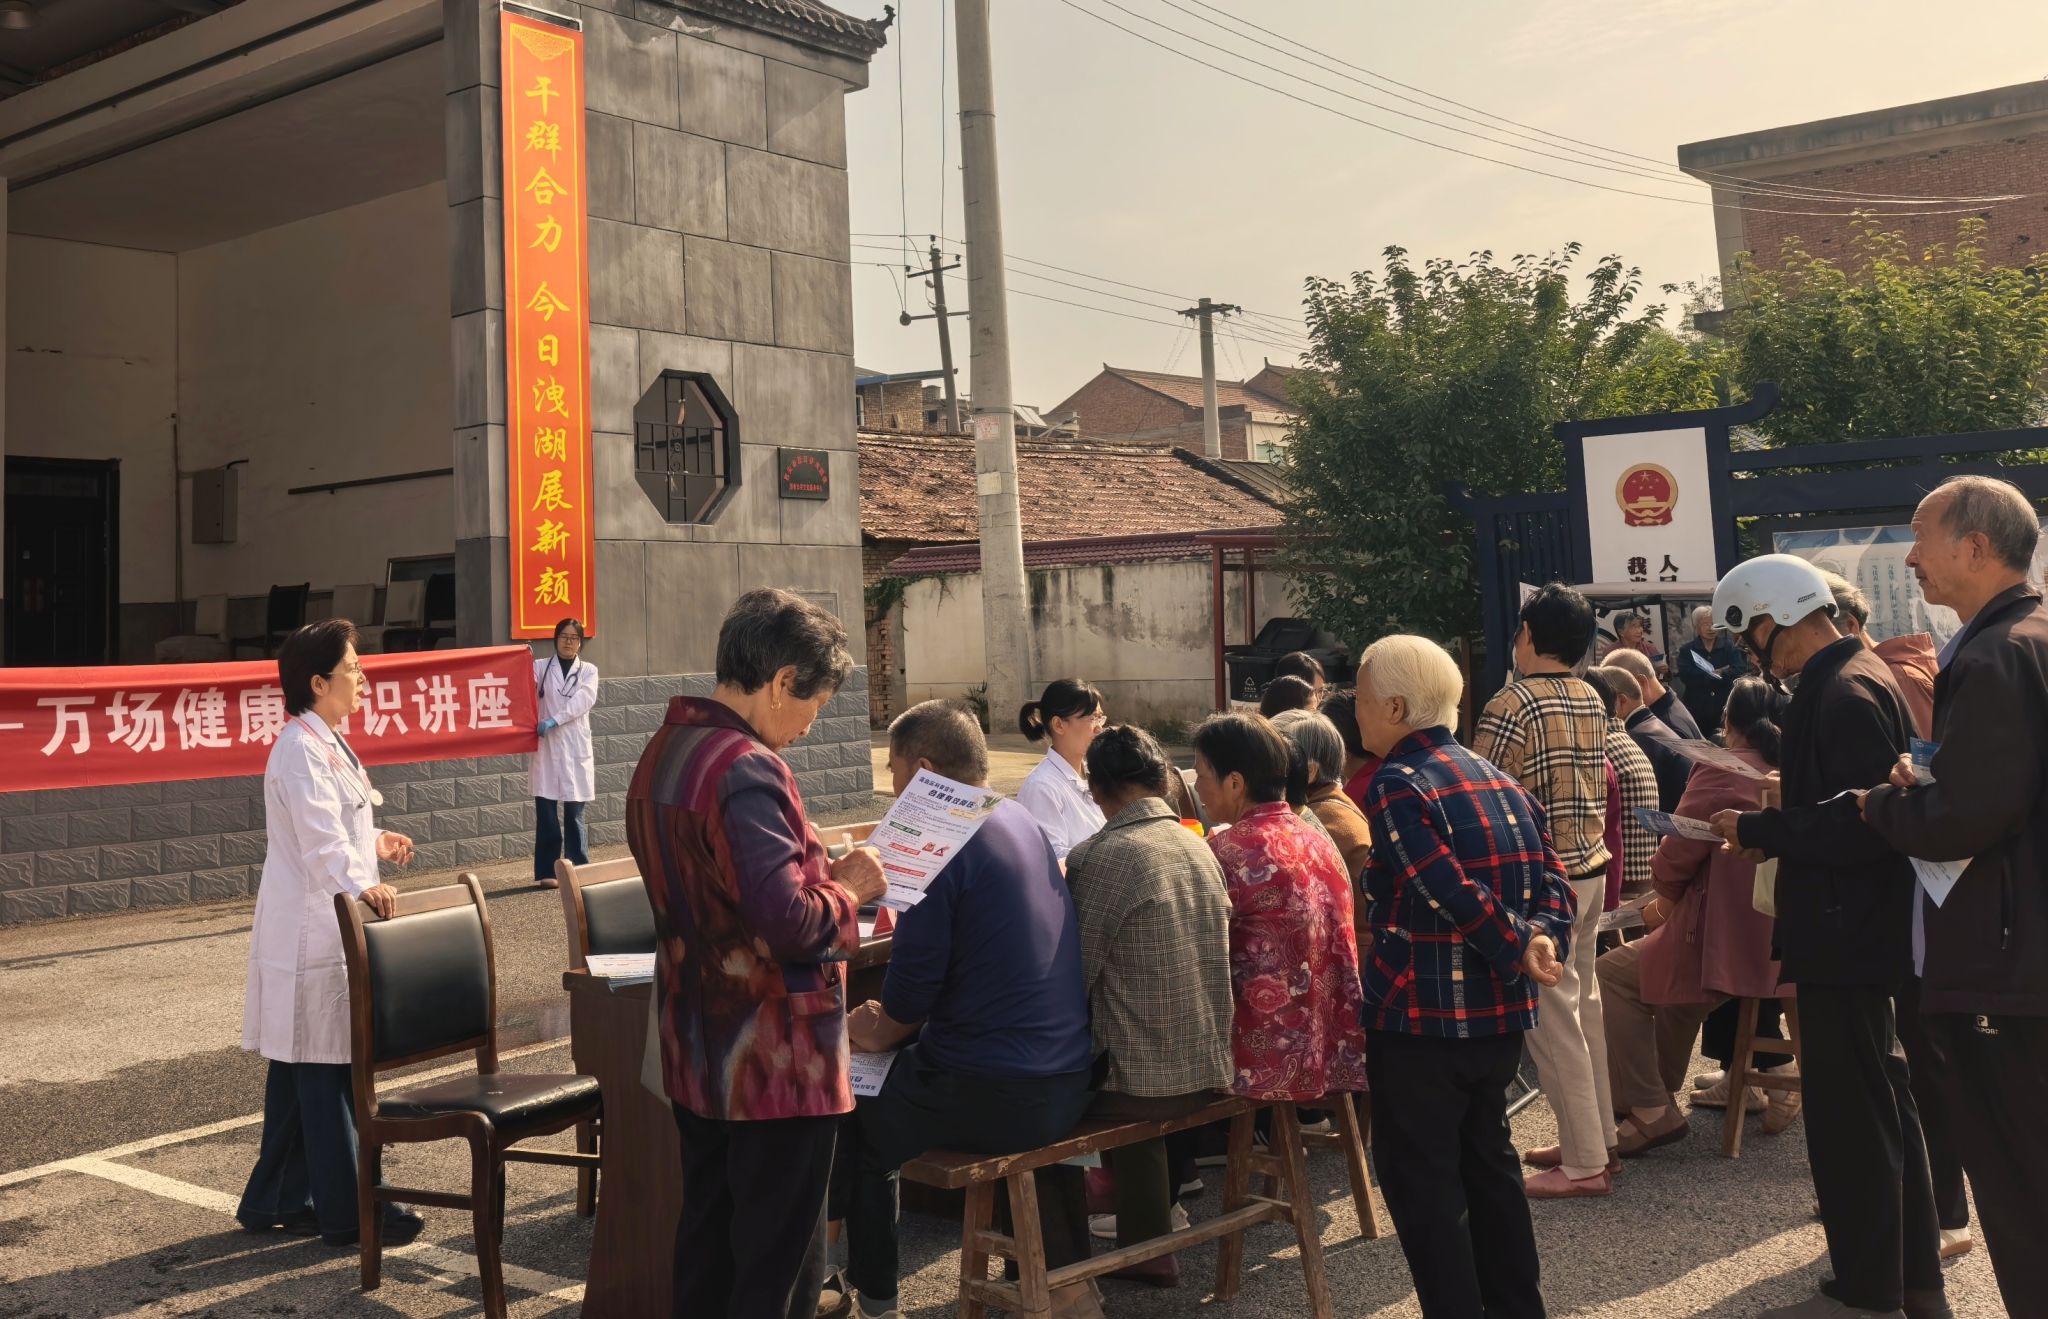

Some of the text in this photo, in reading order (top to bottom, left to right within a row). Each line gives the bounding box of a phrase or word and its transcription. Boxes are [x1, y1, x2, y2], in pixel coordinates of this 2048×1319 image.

[524, 75, 568, 253] 干群合力
[0, 672, 513, 757] 万场健康识讲座
